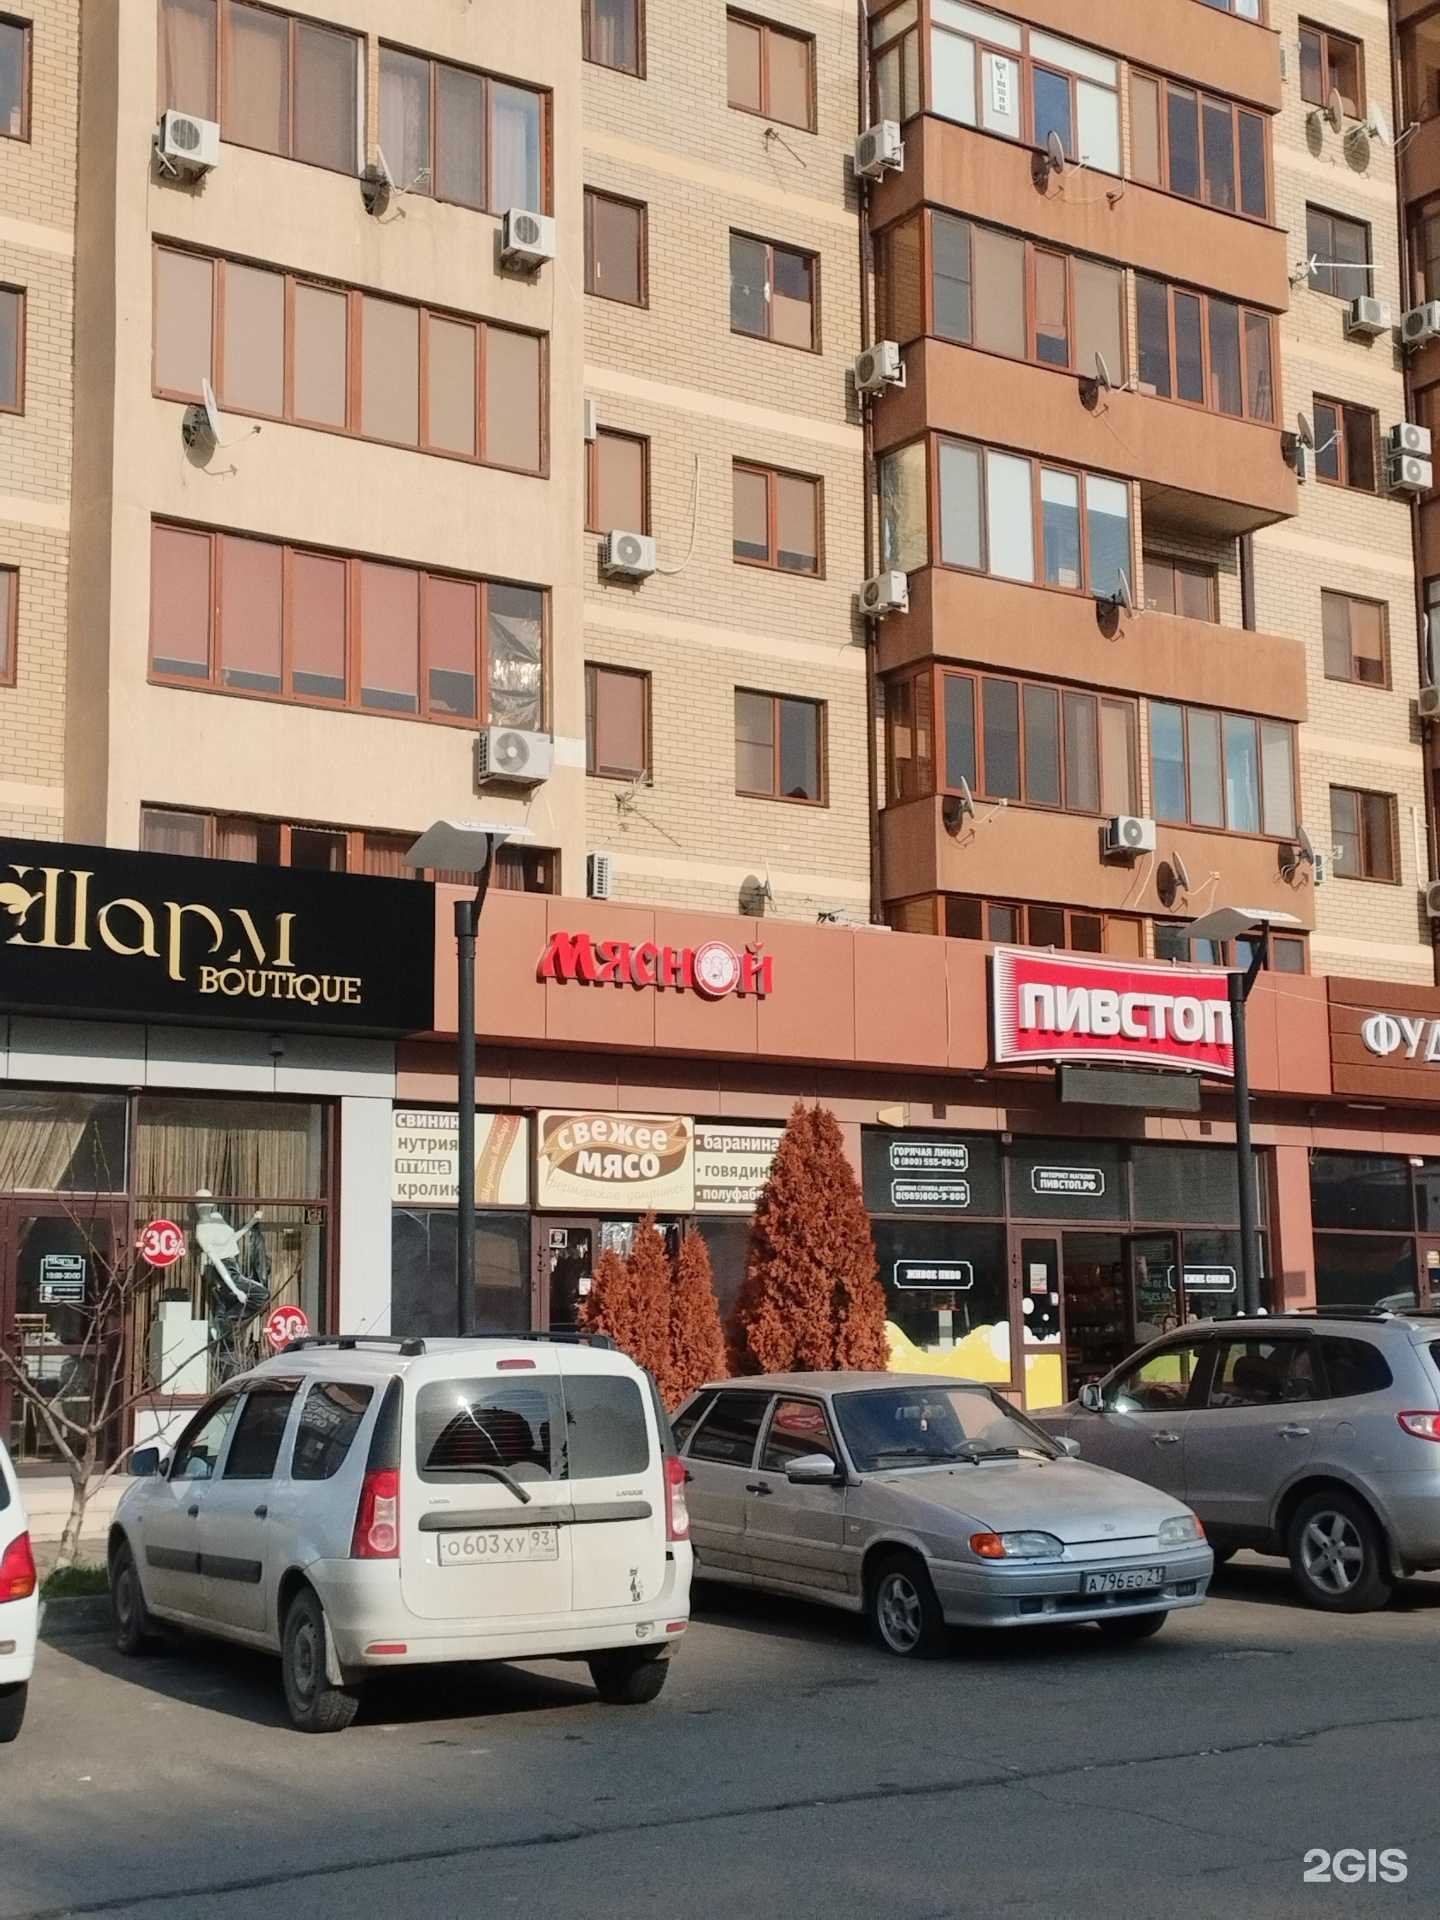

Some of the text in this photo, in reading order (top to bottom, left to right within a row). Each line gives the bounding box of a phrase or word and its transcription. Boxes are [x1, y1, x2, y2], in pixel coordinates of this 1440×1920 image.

[200, 966, 362, 1006] BOUTIQUE
[1018, 982, 1233, 1047] ПИВСТОП
[893, 1147, 964, 1158] ГОРЯЧАЯ ЛИНИЯ
[397, 1159, 450, 1175] птица
[135, 1229, 187, 1257] -30%
